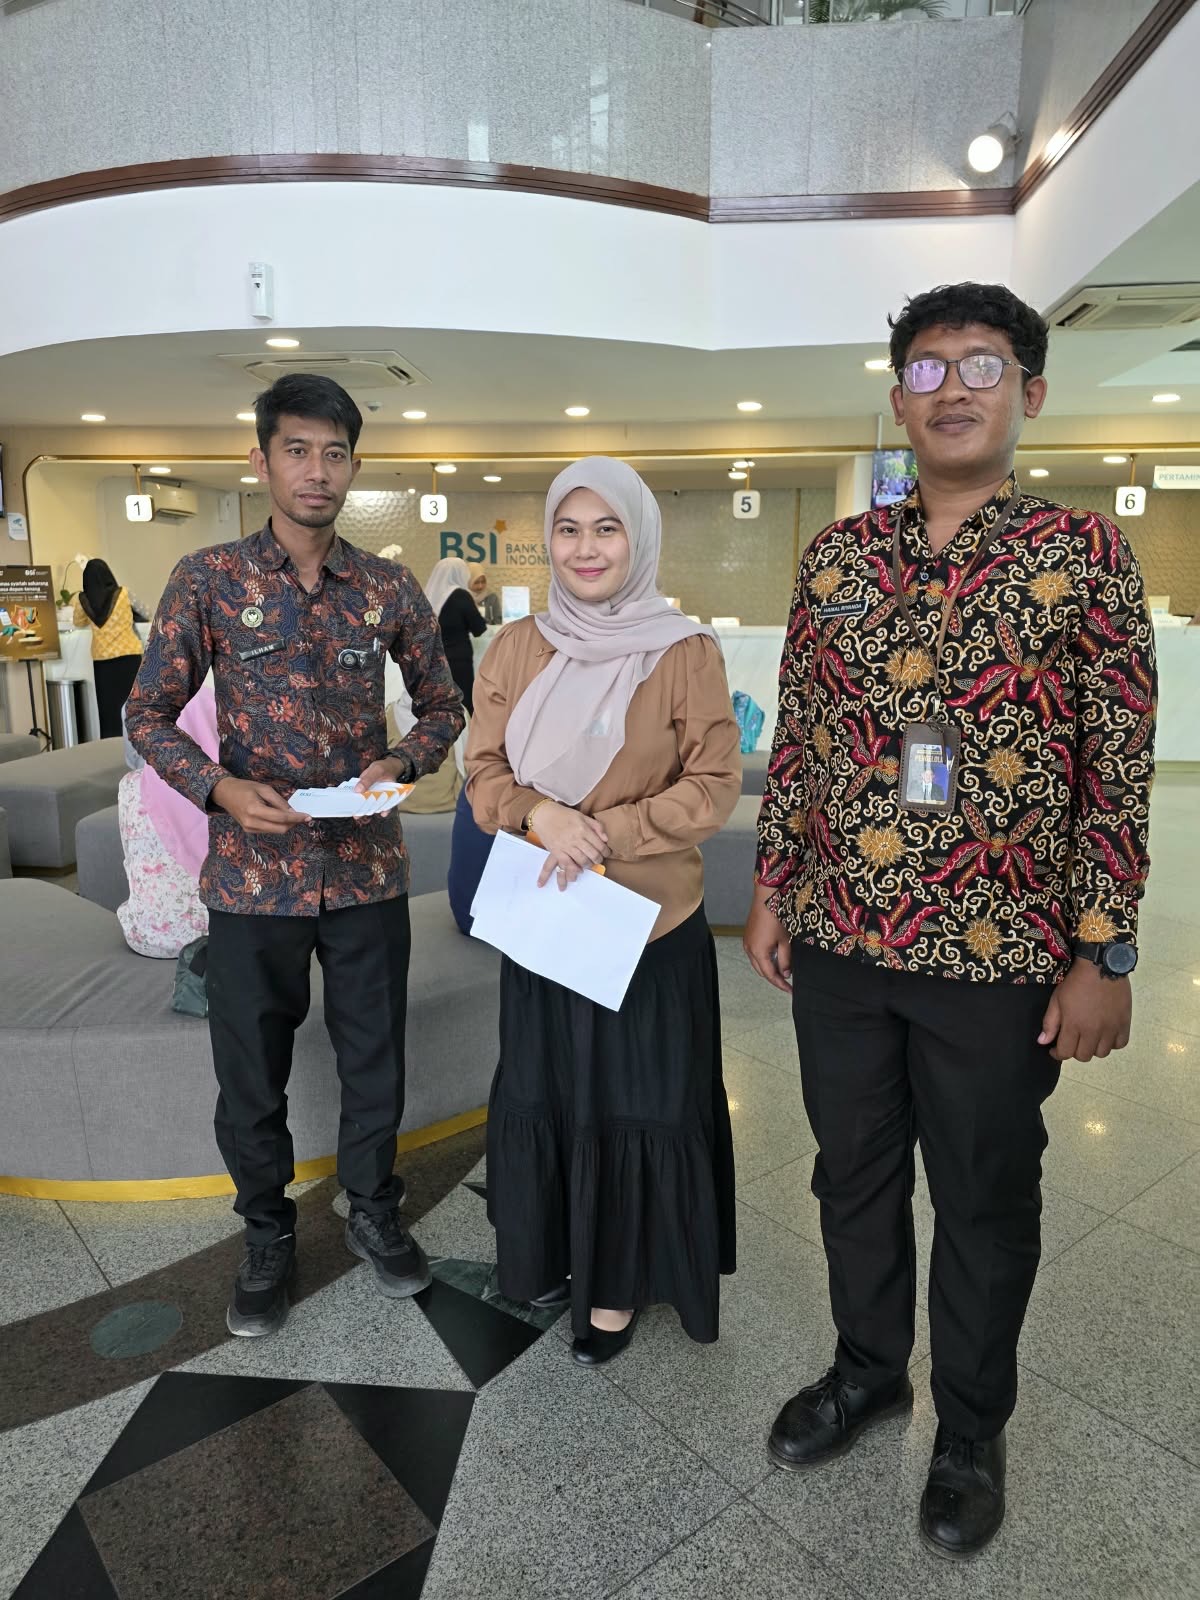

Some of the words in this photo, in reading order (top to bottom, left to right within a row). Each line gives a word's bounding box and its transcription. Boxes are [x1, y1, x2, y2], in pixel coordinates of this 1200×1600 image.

[133, 500, 141, 516] 1
[429, 500, 439, 516] 3
[740, 495, 752, 513] 5
[1124, 493, 1136, 510] 6
[439, 530, 498, 565] BSI
[505, 543, 538, 554] BANK
[505, 555, 551, 566] INDONE
[251, 644, 275, 656] ILHAM
